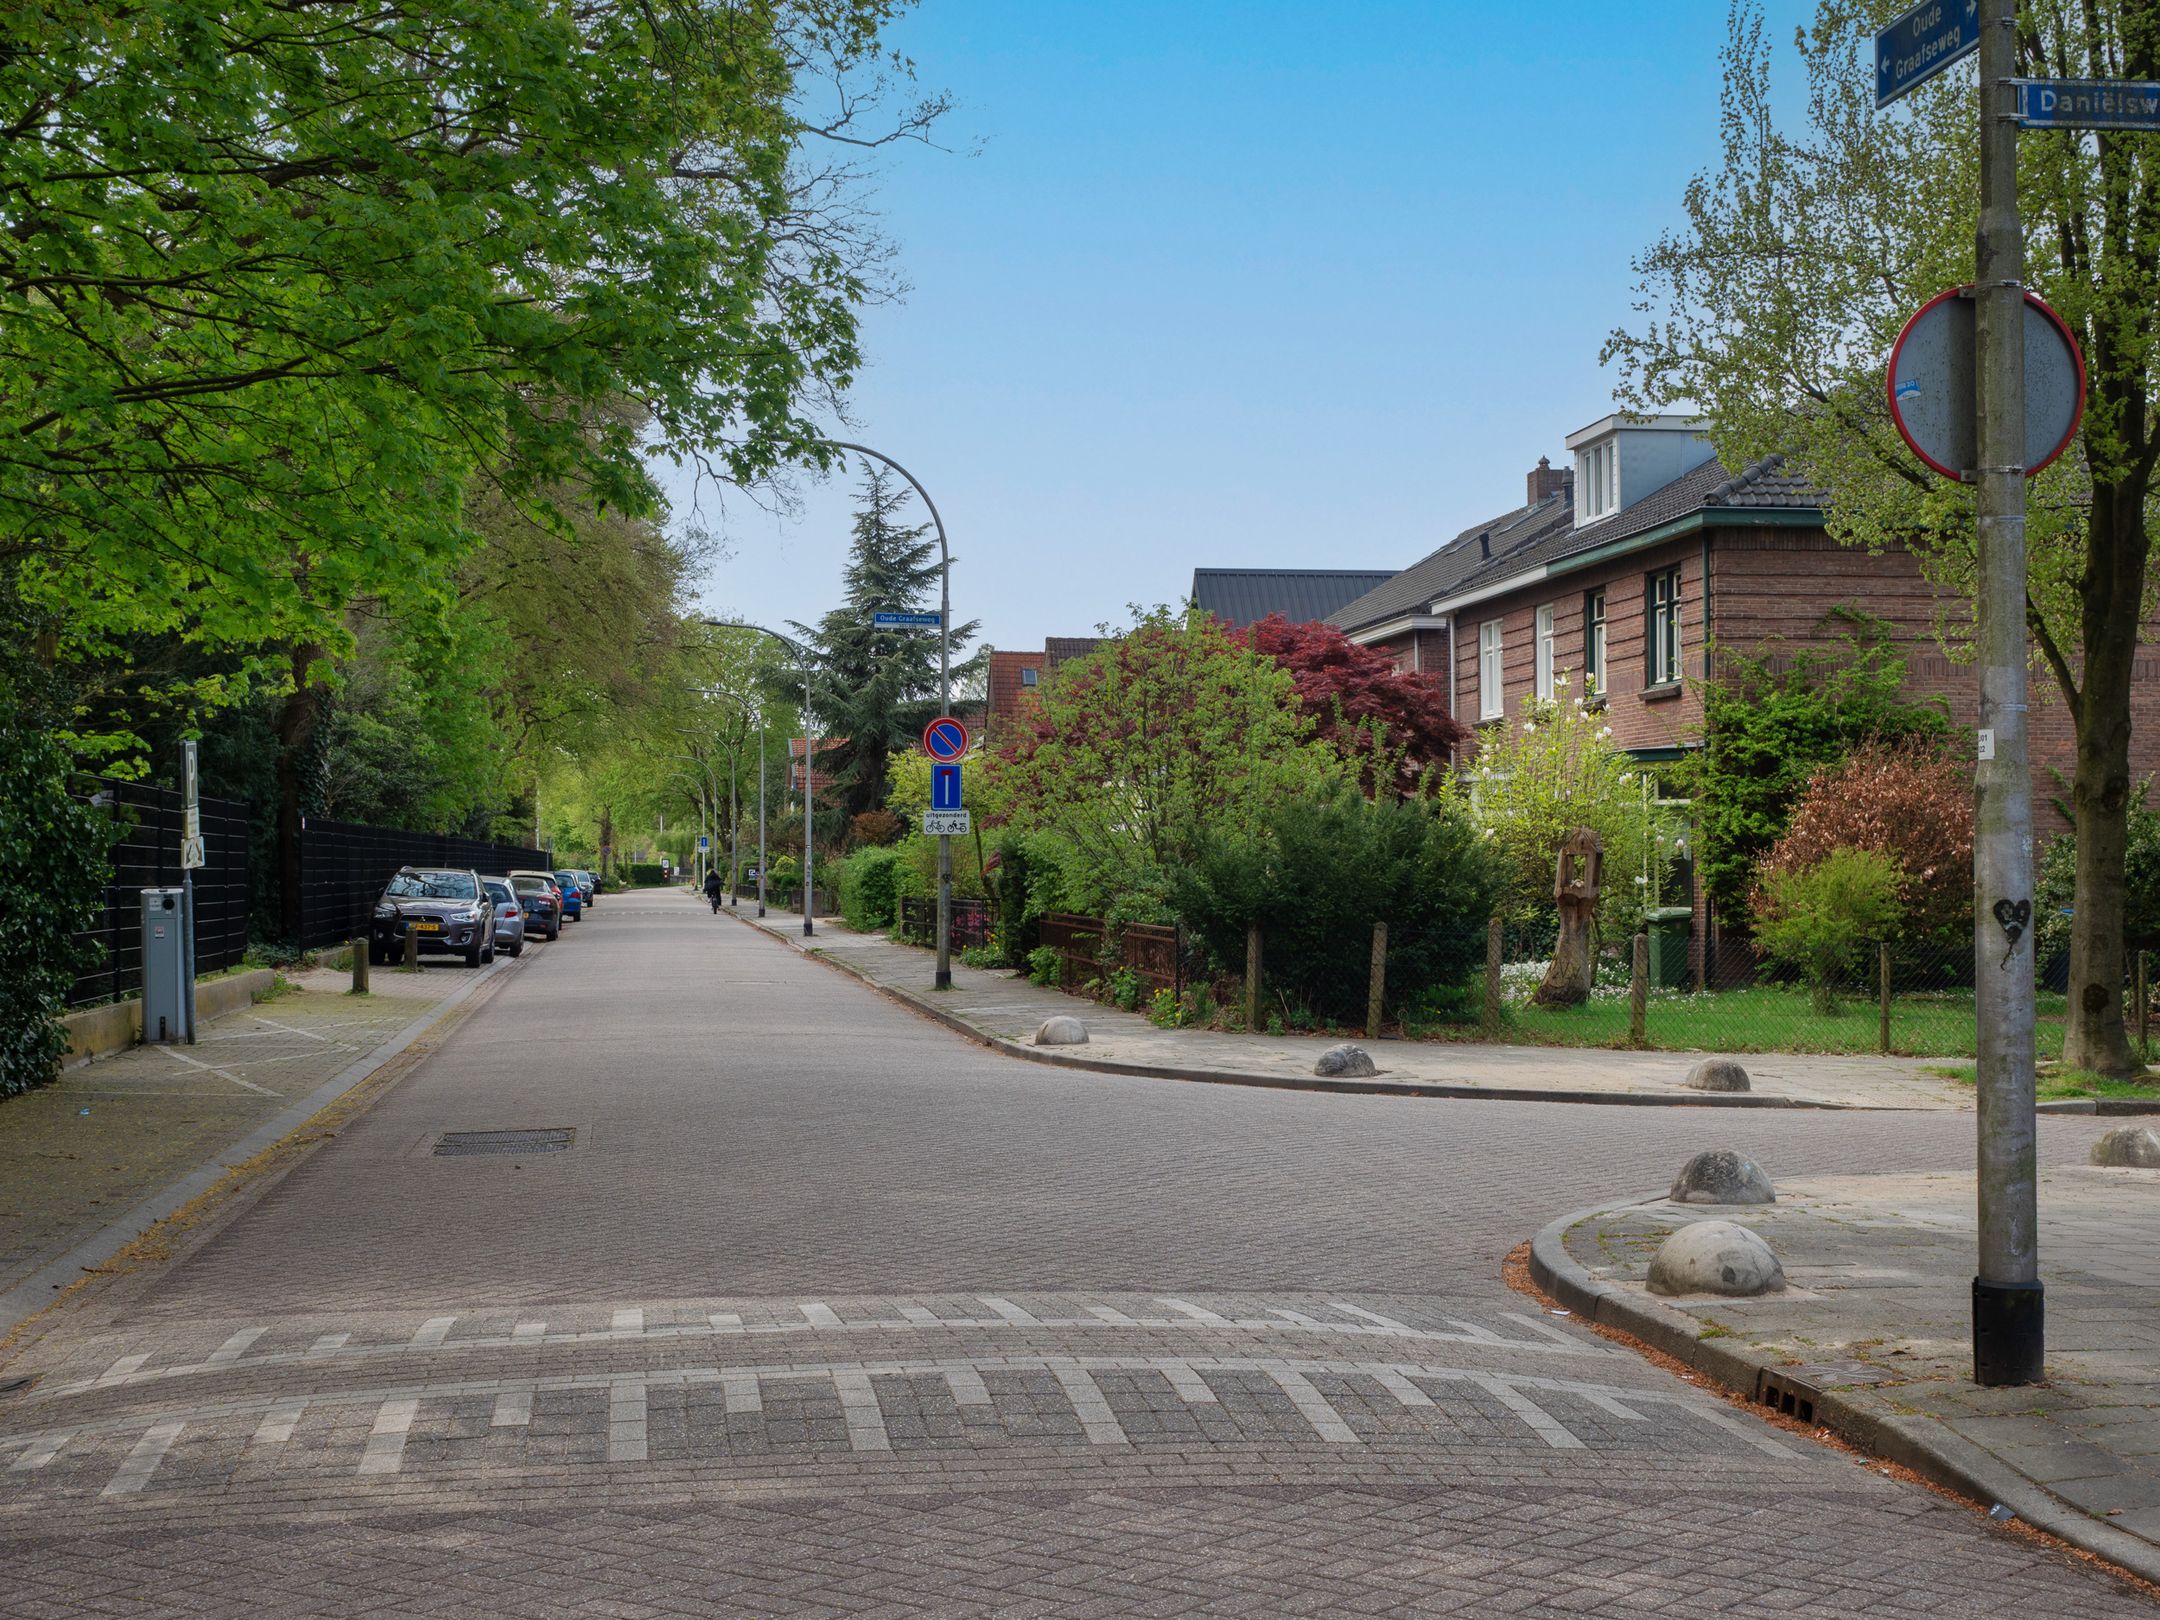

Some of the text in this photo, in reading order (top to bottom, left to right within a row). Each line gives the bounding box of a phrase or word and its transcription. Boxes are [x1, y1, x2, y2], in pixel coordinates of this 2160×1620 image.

[1913, 5, 1942, 37] Oude
[1896, 25, 1960, 79] Graafseweg
[2041, 89, 2160, 114] Daniëlsw
[898, 615, 935, 624] Graafseweg
[188, 751, 196, 800] P
